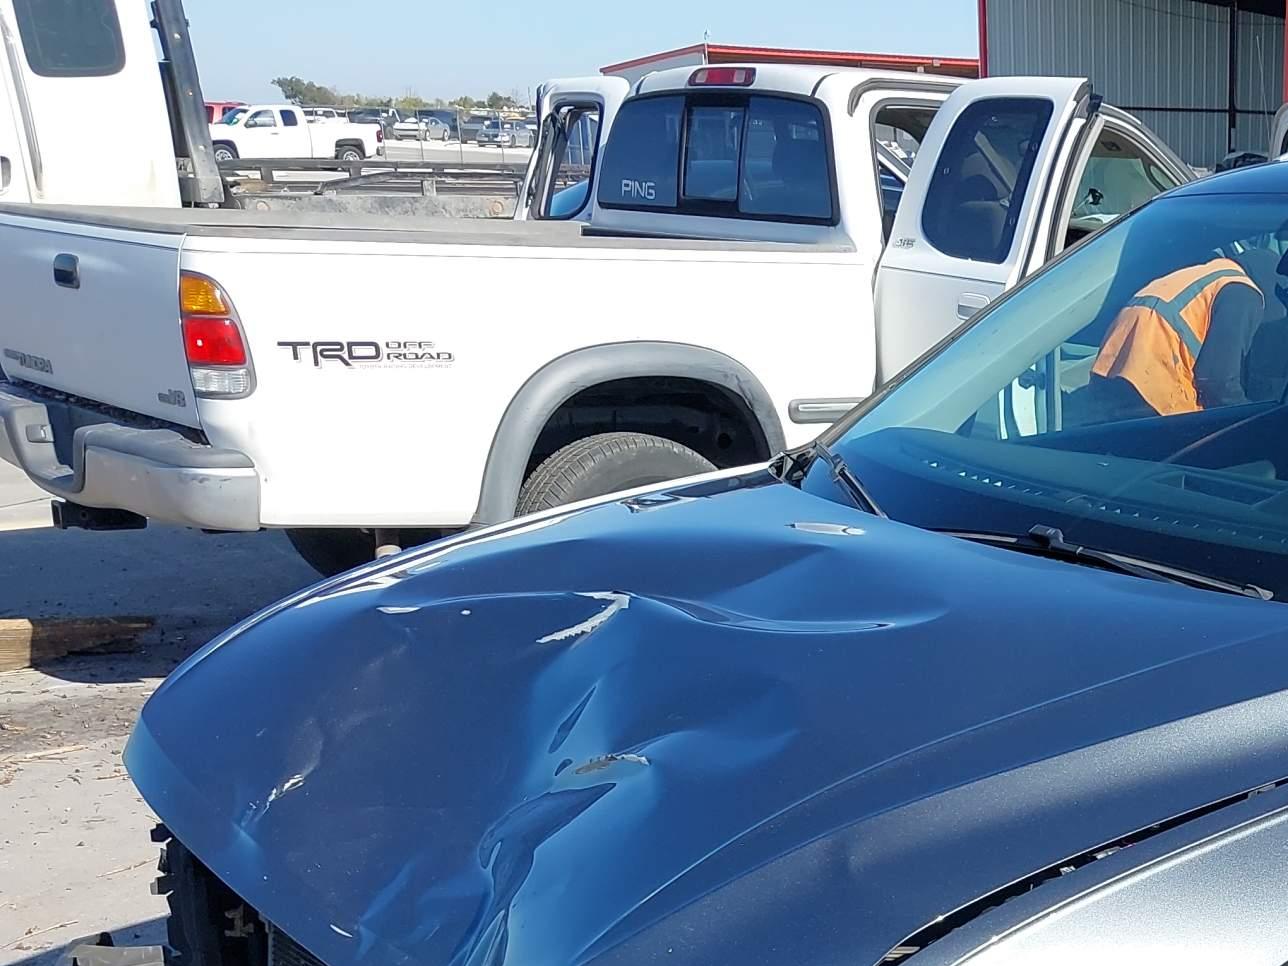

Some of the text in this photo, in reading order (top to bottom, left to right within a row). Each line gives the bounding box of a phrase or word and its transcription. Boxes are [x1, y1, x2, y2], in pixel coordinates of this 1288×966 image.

[621, 179, 656, 200] PING
[385, 341, 435, 350] OFF
[276, 341, 382, 367] TRD
[386, 352, 453, 361] ROAD
